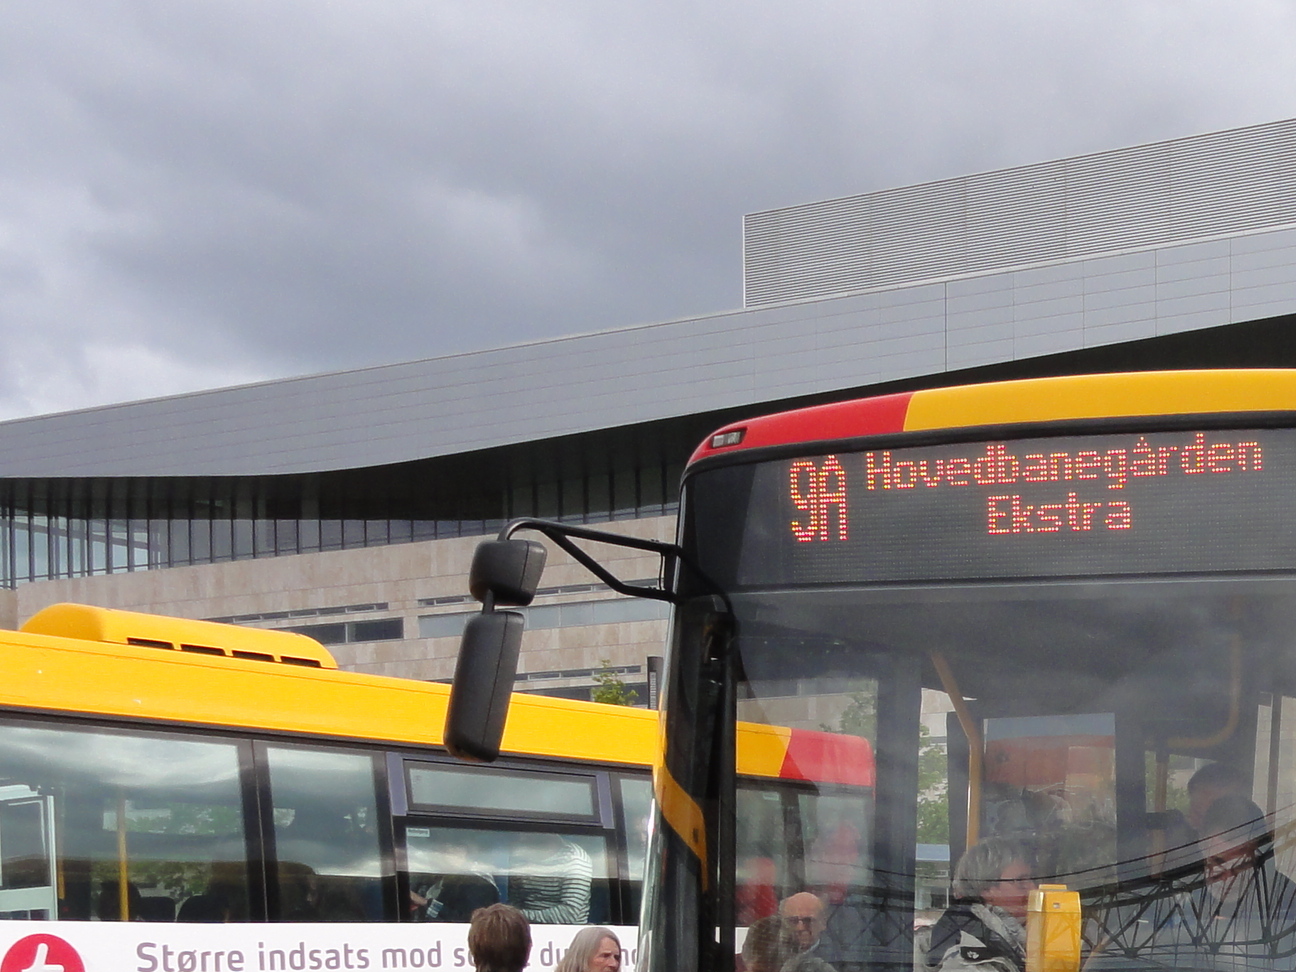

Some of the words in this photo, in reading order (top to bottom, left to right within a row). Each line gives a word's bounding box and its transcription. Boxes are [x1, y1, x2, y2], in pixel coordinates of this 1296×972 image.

[865, 432, 1263, 490] Hovedbanegården
[789, 454, 847, 543] 9A
[987, 492, 1131, 535] Ekstra
[258, 941, 370, 971] indsats
[382, 940, 442, 970] mod
